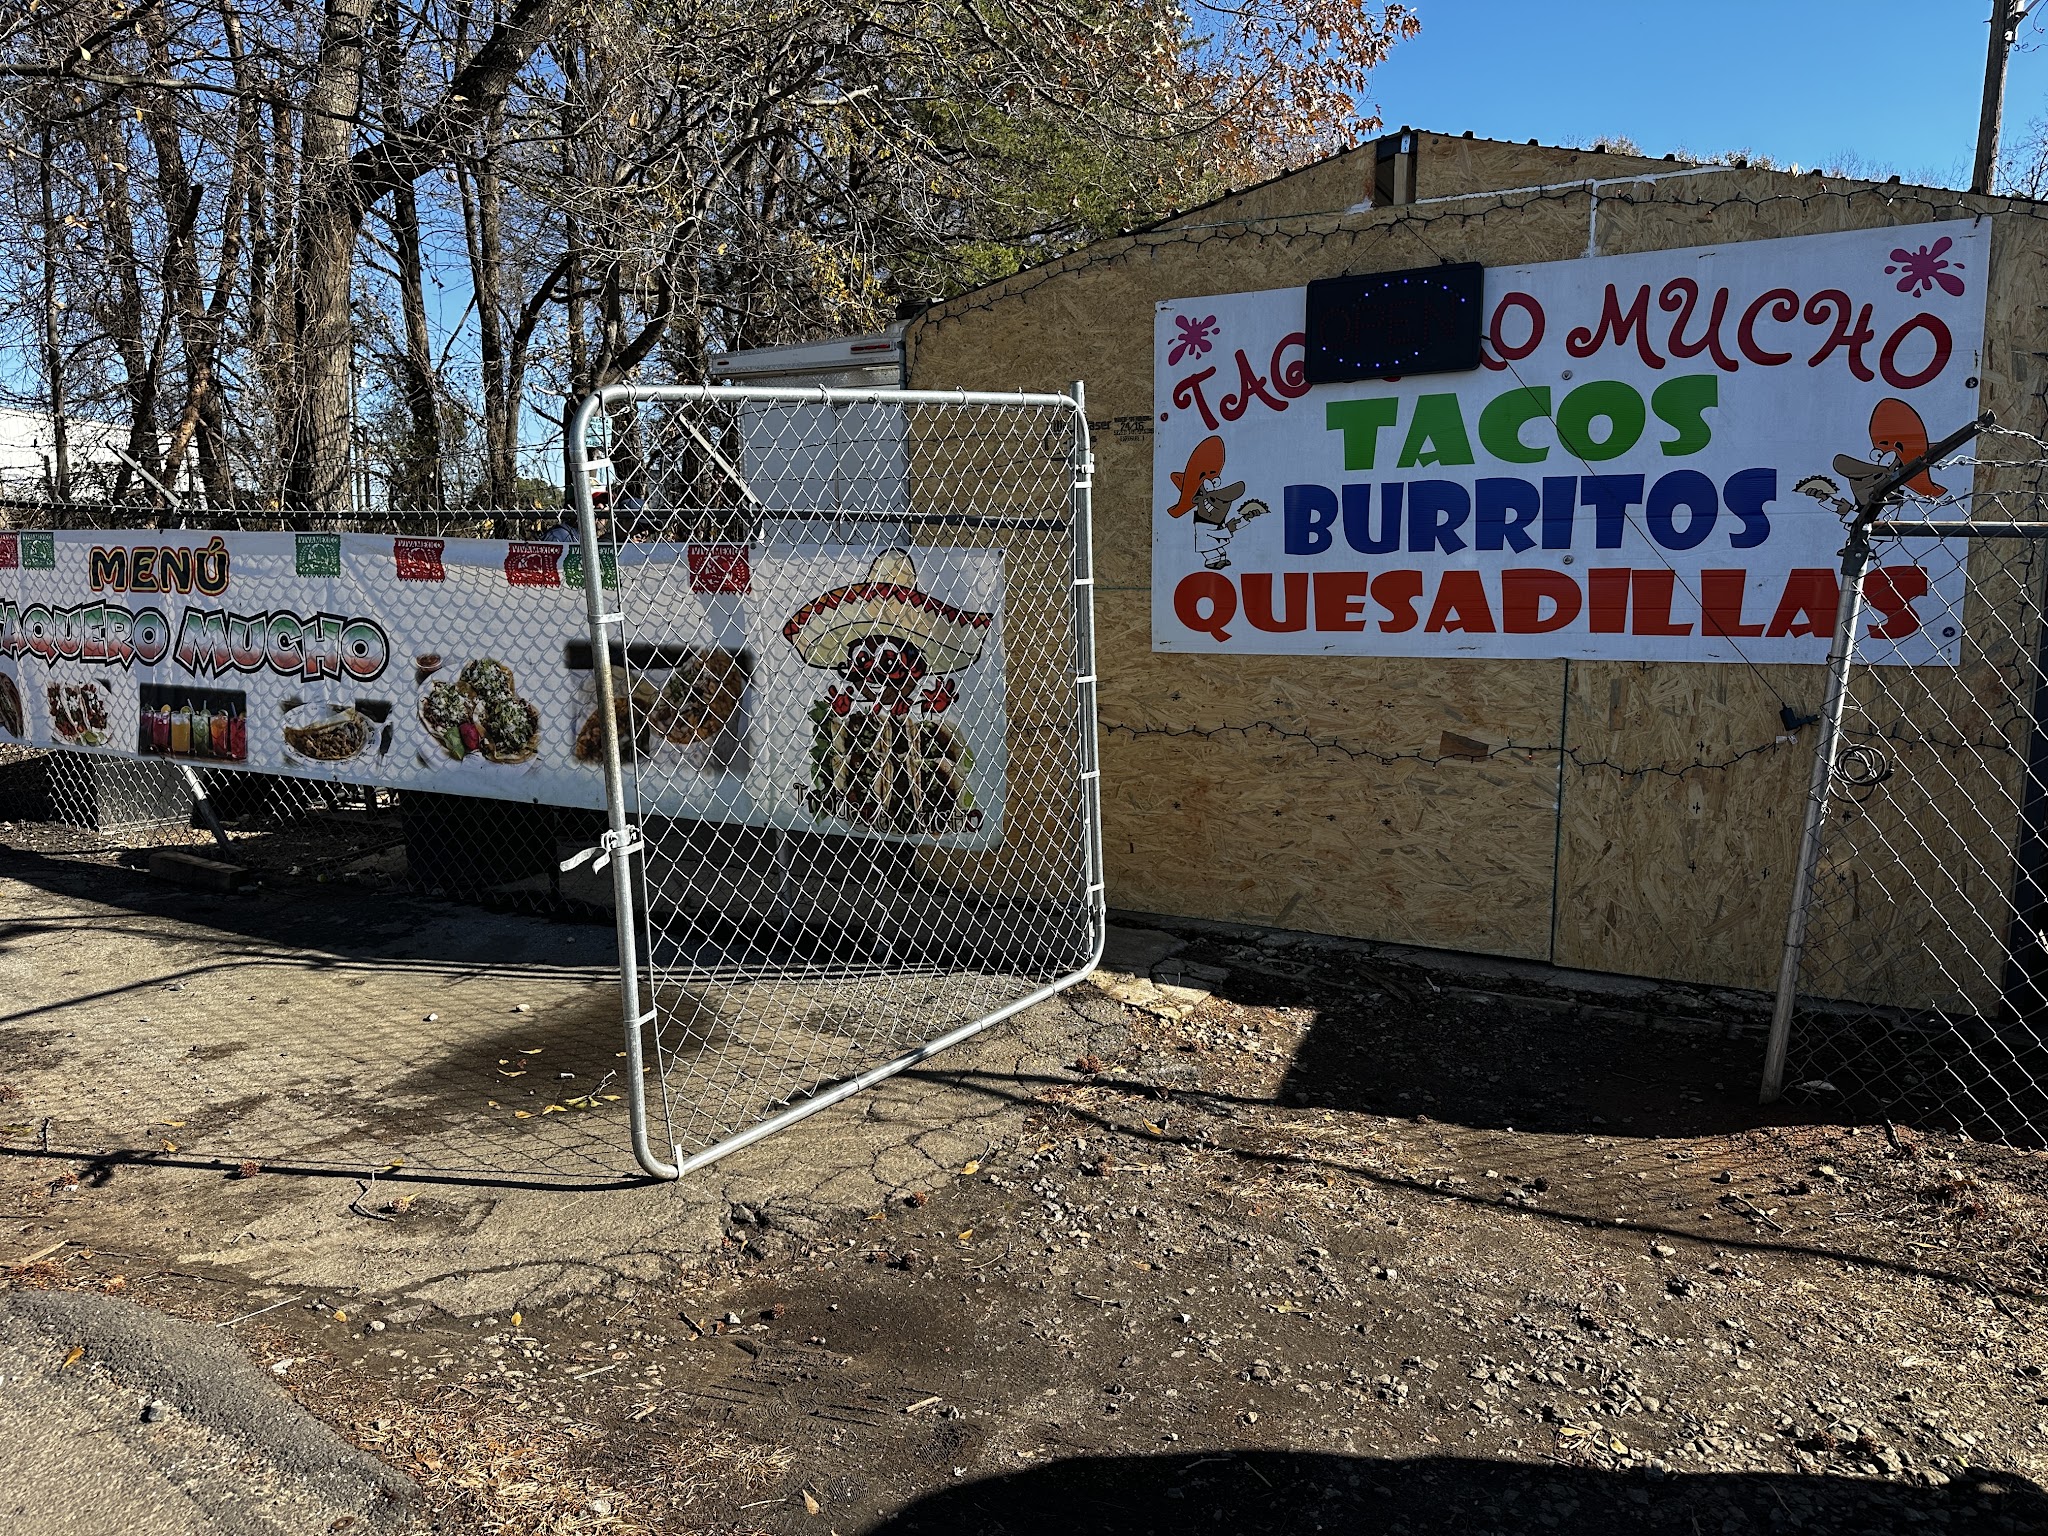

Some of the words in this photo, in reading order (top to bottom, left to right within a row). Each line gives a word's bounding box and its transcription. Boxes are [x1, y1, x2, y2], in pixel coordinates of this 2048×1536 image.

[1172, 291, 1546, 430] TAQO
[1565, 277, 1953, 390] MUCHO
[1325, 374, 1719, 471] TACOS
[1283, 467, 1778, 556] BURRITOS
[89, 535, 231, 597] MENÚ
[1173, 566, 1929, 643] QUESADILLAS
[172, 605, 390, 684] MUCHO
